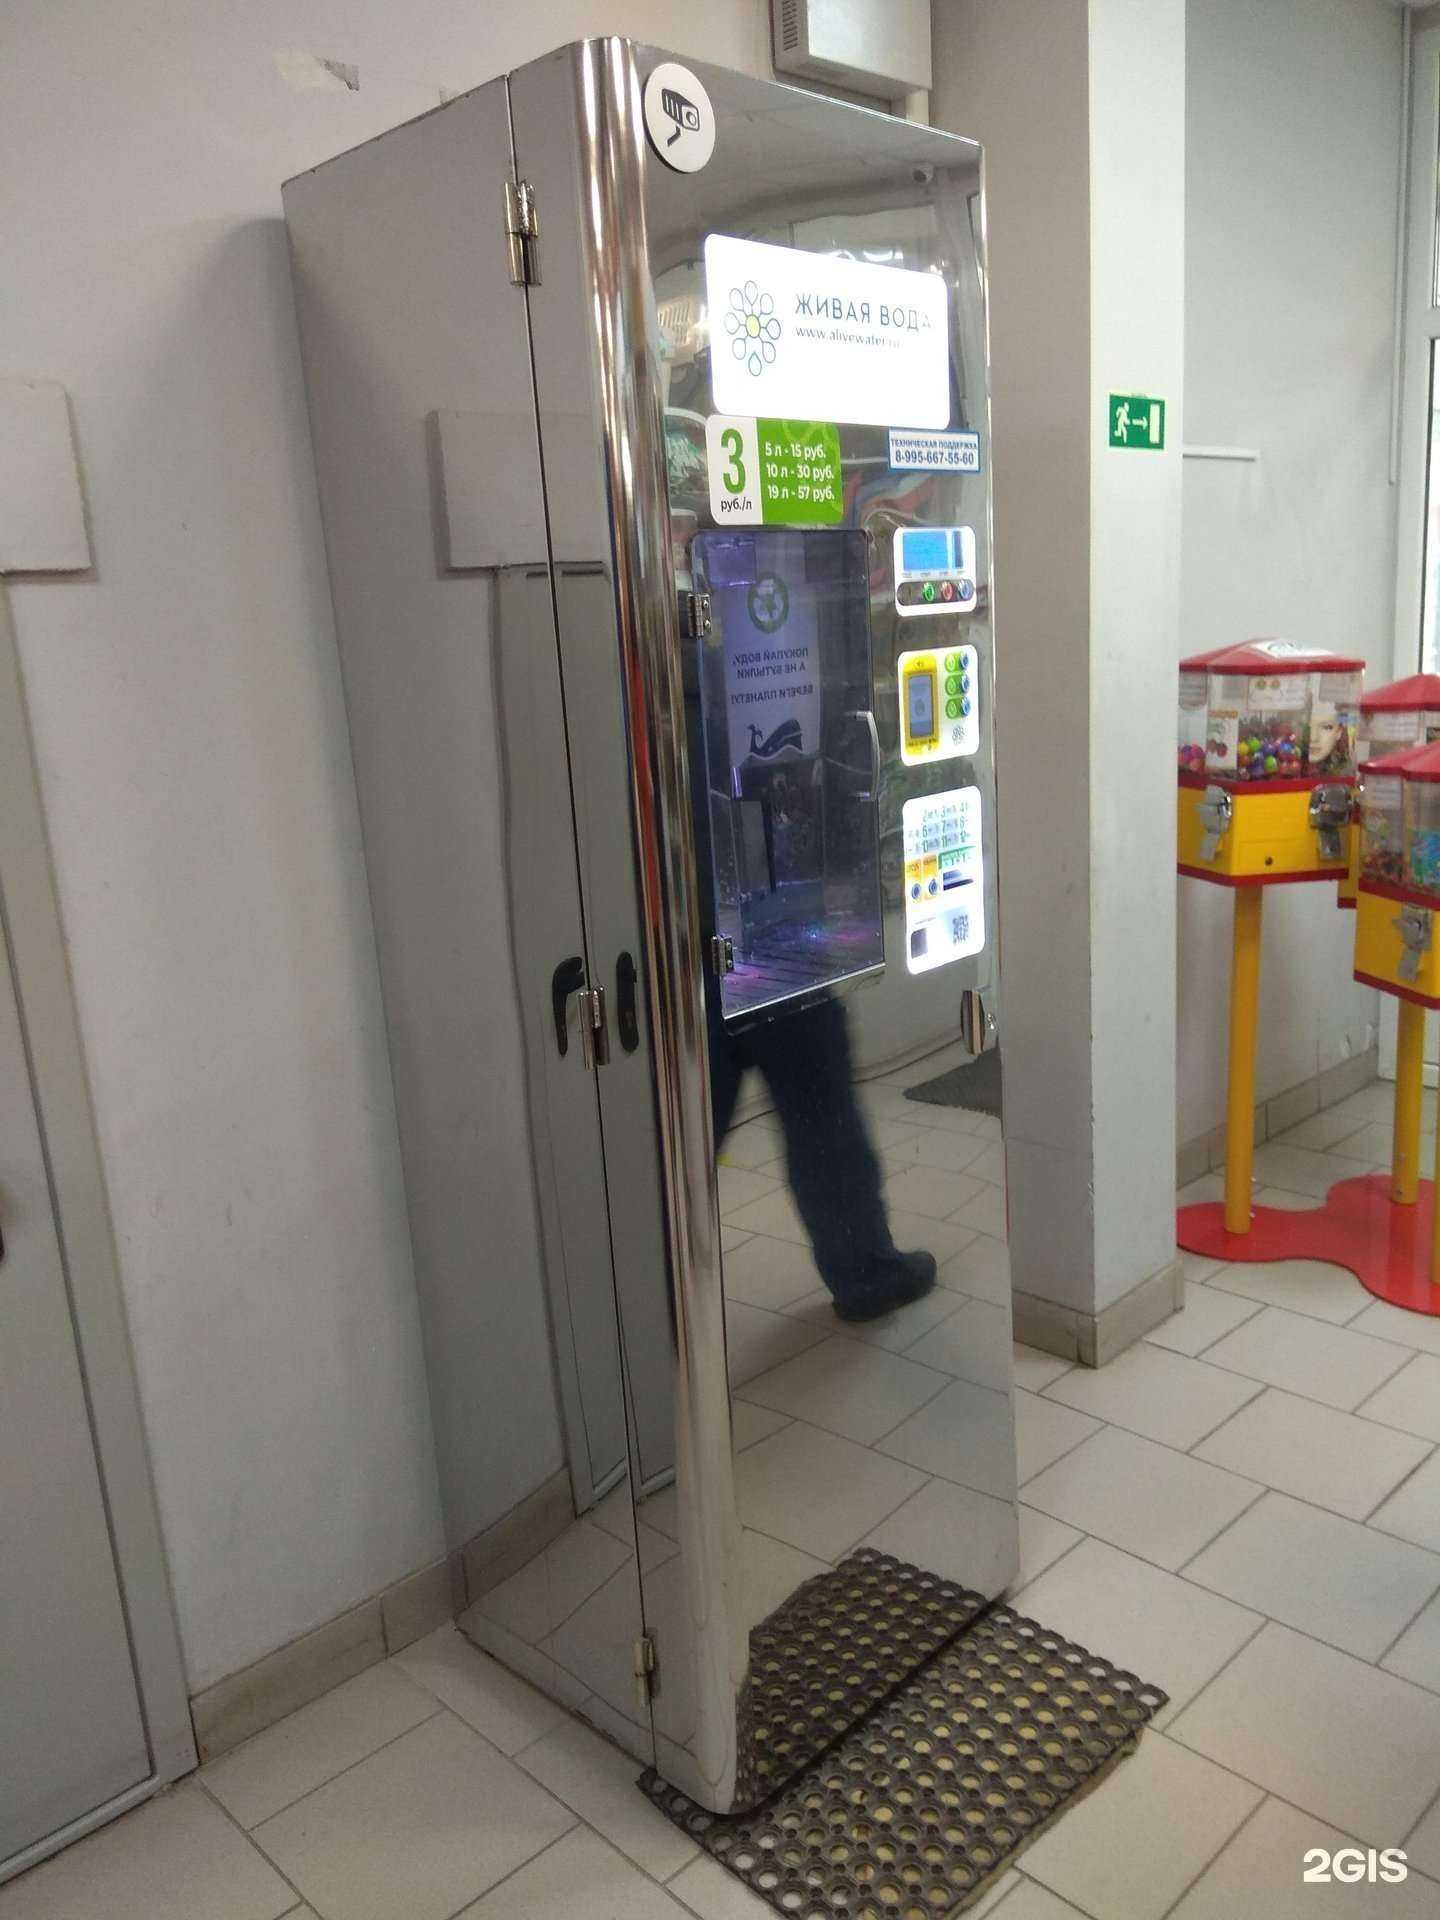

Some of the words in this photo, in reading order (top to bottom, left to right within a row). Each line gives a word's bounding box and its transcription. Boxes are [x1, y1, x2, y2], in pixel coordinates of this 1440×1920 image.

[795, 293, 870, 324] ЖИВАЯ
[765, 442, 772, 457] 5
[774, 445, 782, 457] л
[791, 443, 801, 458] 15
[804, 444, 826, 461] руб.
[895, 450, 974, 465] 8-995-667-55-60
[721, 428, 746, 494] 3
[766, 463, 778, 478] 10
[781, 466, 788, 478] л
[797, 464, 810, 479] 30
[813, 464, 834, 481] руб.
[768, 485, 779, 499] 19
[781, 487, 789, 499] л
[798, 486, 810, 500] 57
[813, 485, 835, 502] руб.
[720, 497, 752, 512] руб./л
